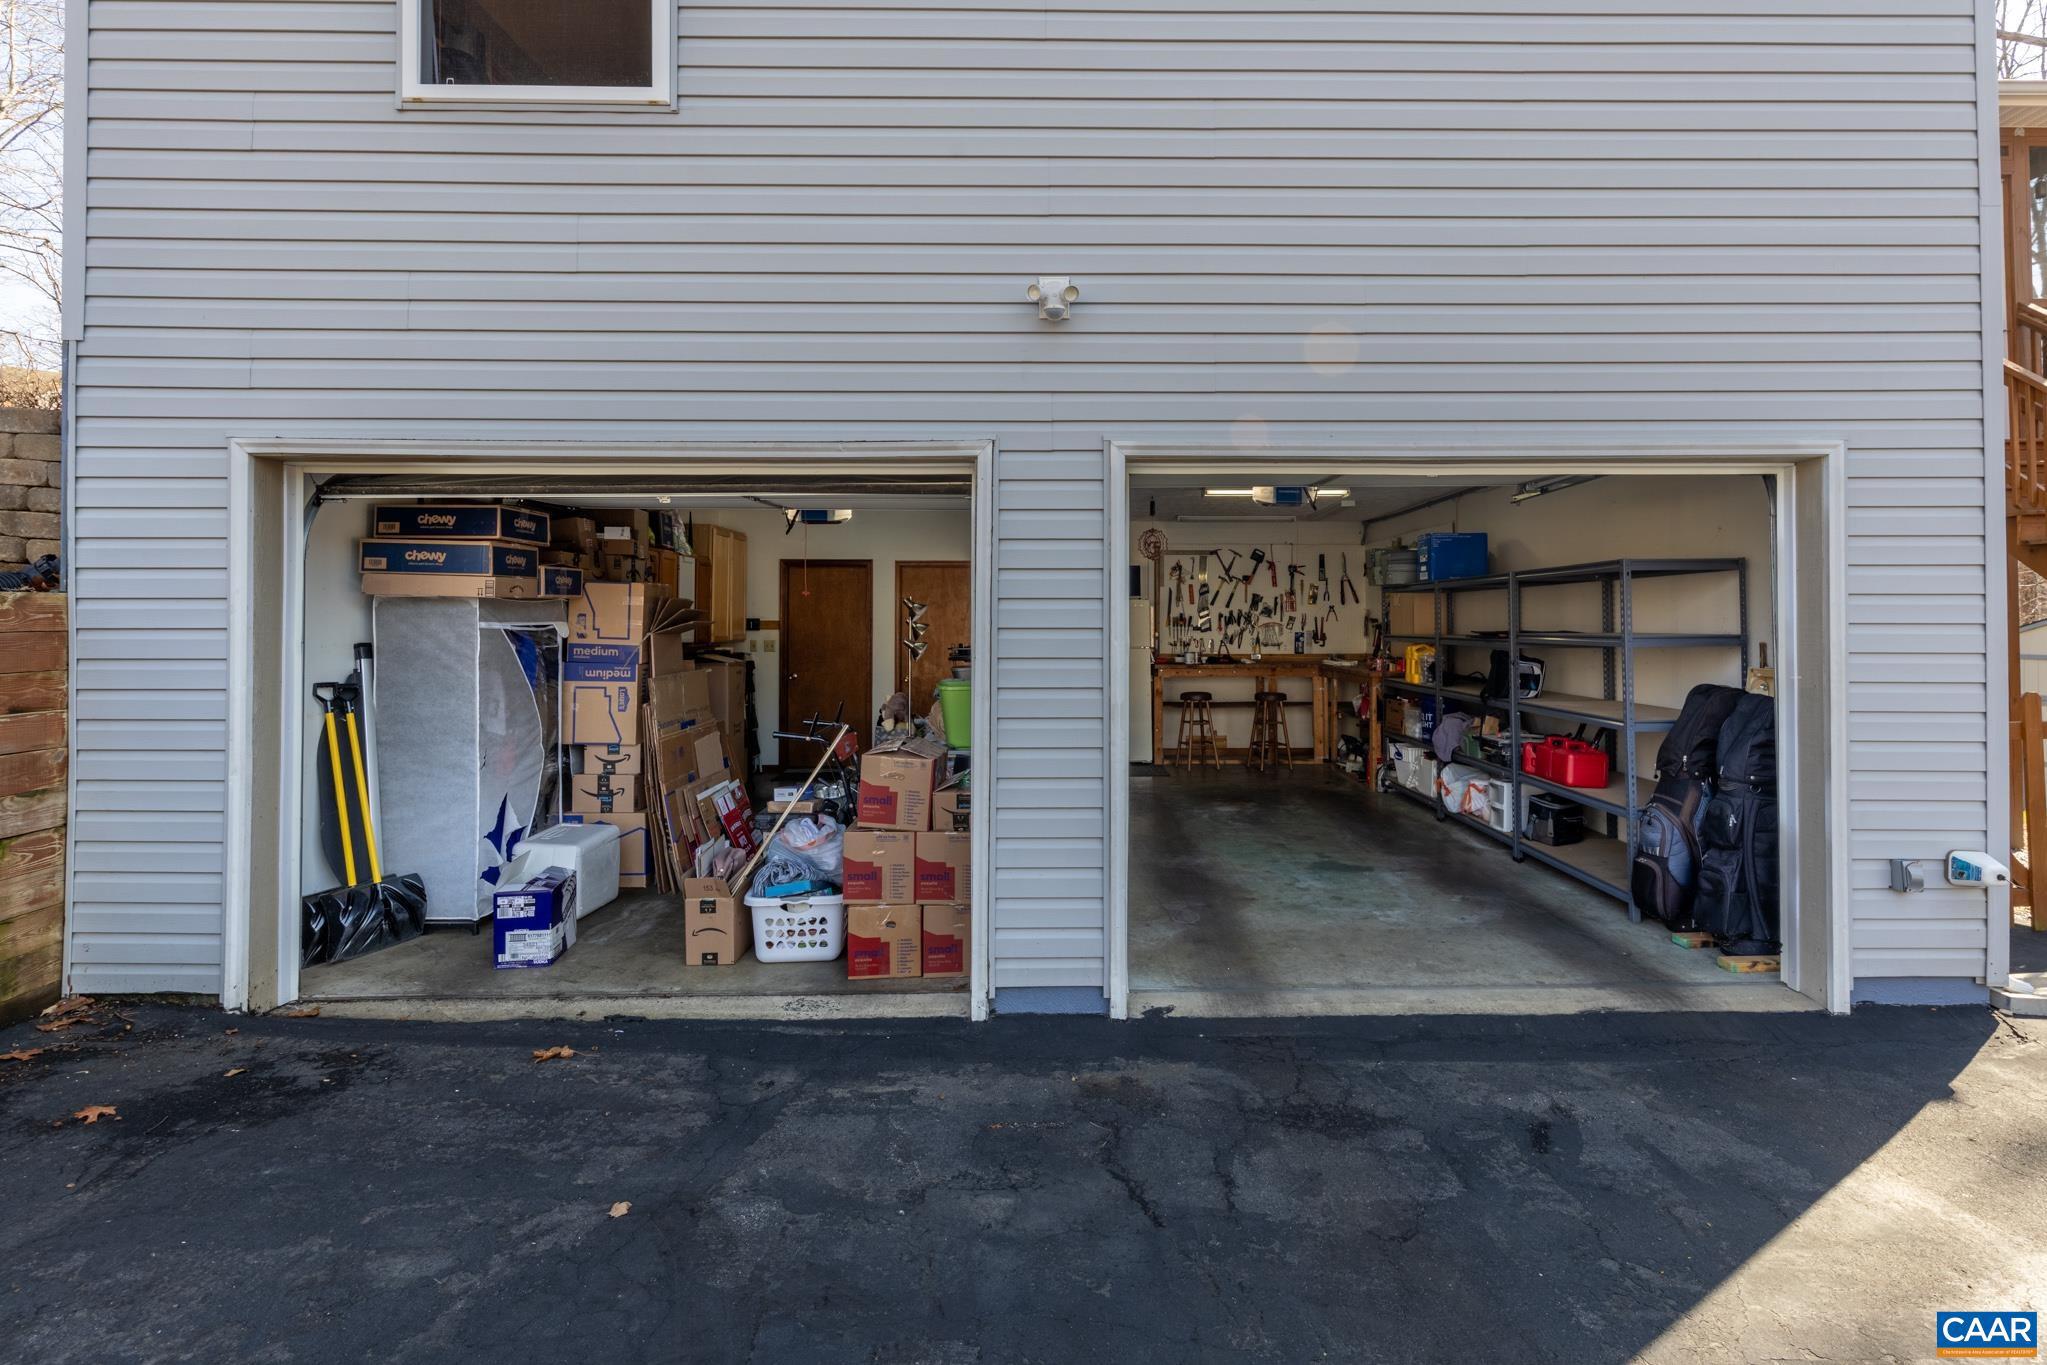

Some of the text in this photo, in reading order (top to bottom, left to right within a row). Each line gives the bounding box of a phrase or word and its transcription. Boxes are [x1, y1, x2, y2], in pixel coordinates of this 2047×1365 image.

[417, 513, 456, 527] chewy
[513, 516, 537, 532] chewy
[405, 548, 447, 563] chewy
[505, 553, 527, 567] chewy
[555, 574, 573, 586] chewy
[573, 646, 619, 657] medium
[585, 668, 632, 681] medium
[863, 794, 892, 806] small
[847, 871, 877, 881] small
[920, 871, 950, 881] small
[927, 943, 957, 954] small
